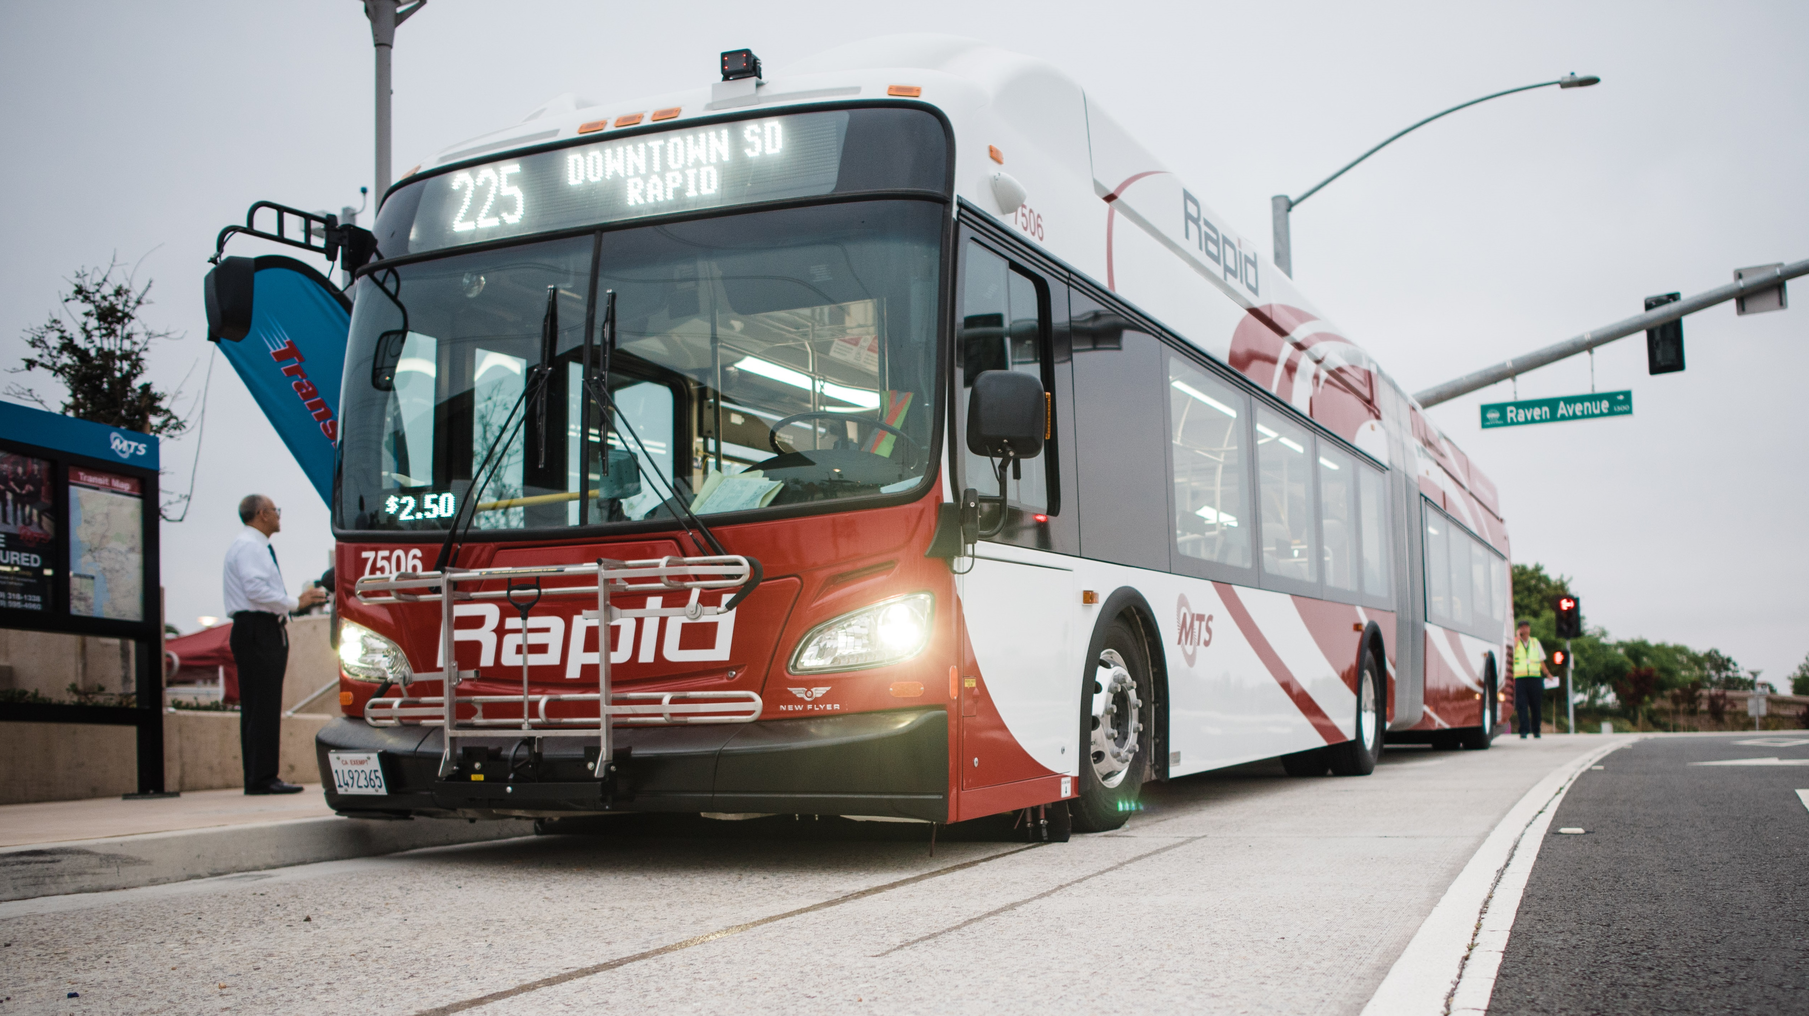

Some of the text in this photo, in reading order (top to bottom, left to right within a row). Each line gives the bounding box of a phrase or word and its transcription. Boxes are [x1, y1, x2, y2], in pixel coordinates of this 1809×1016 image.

[566, 120, 784, 187] DOWNTOWN SD
[452, 163, 525, 234] 225
[626, 165, 719, 207] RAPID
[1182, 186, 1260, 298] Rapid
[1506, 405, 1550, 424] Raven
[1557, 399, 1610, 419] Avenue
[110, 436, 147, 456] MTS
[78, 471, 132, 491] Transit Map
[385, 492, 456, 521] $2.50
[361, 548, 423, 578] 7506
[436, 593, 738, 679] Rapid
[1177, 612, 1214, 648] MTS
[807, 703, 840, 711] FLYER
[335, 769, 383, 789] 1492365
